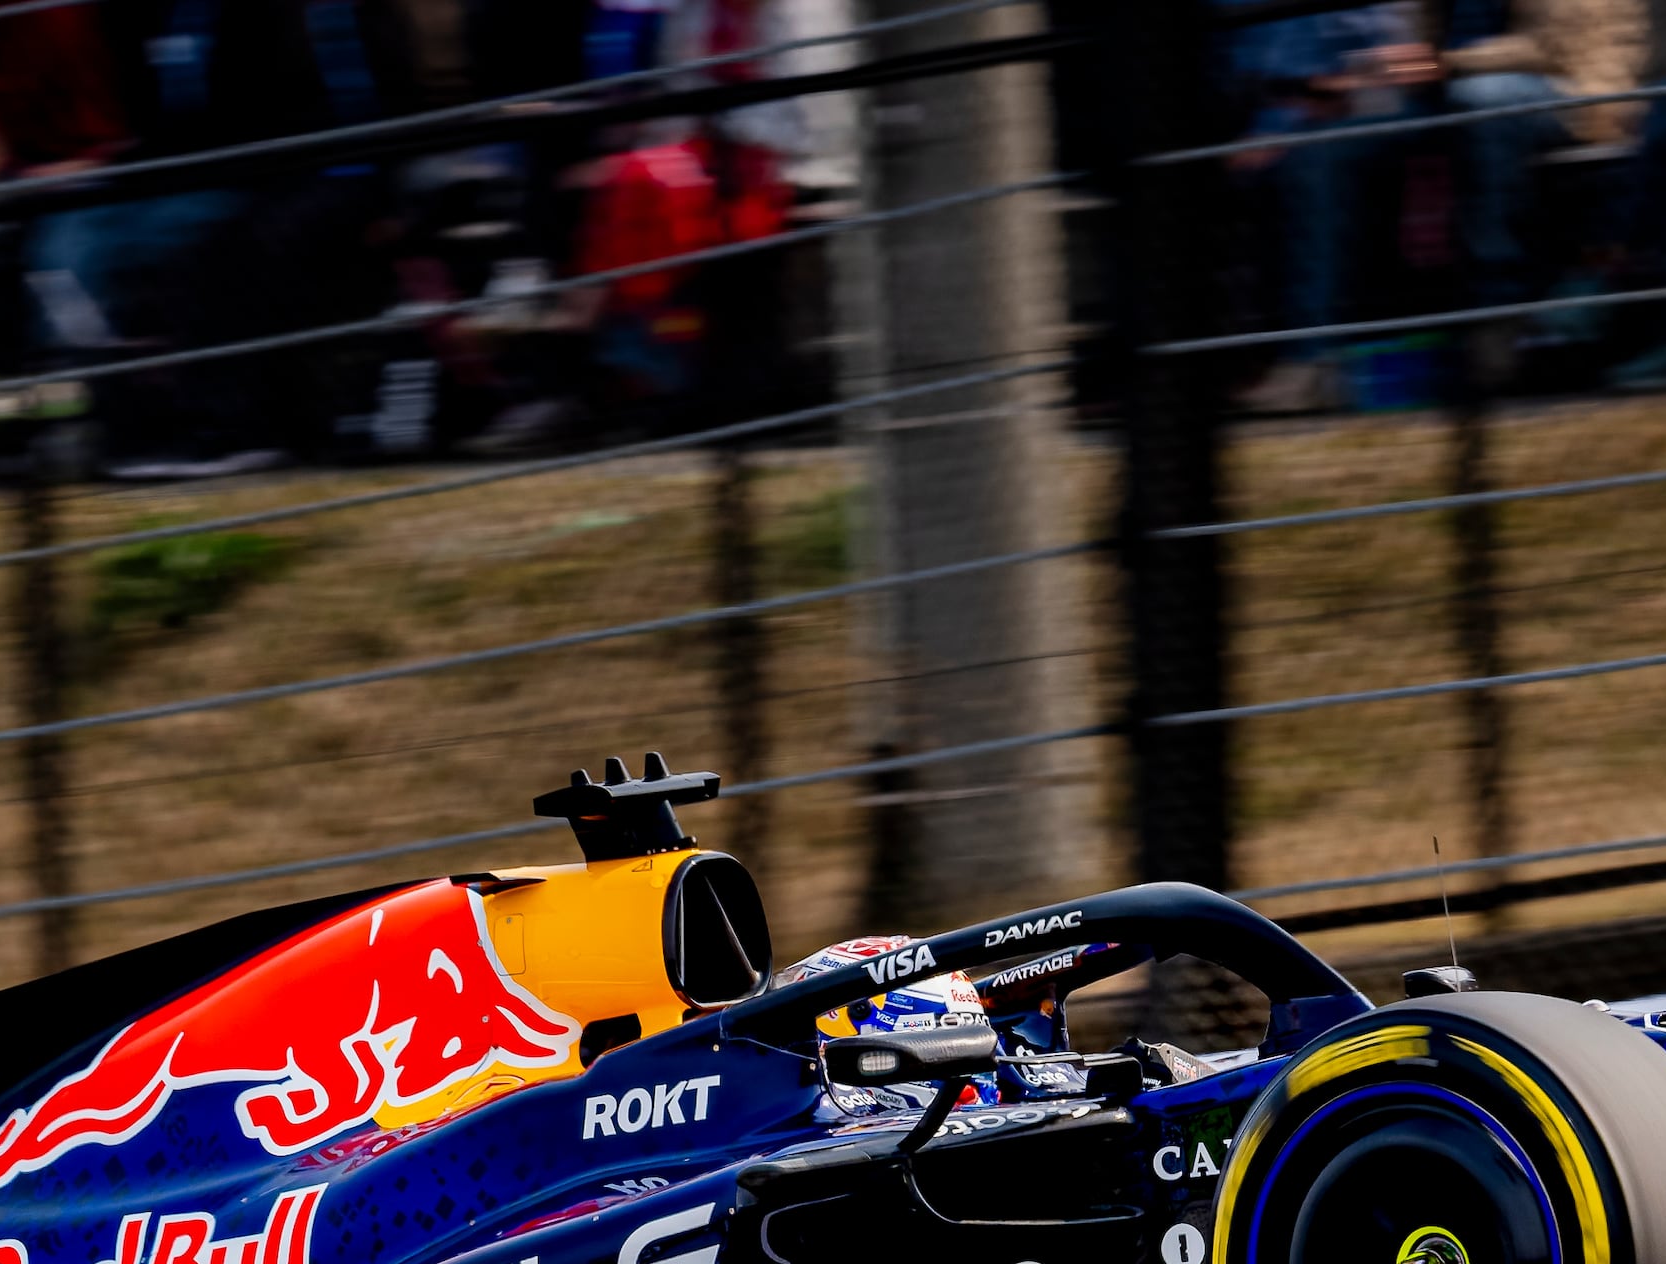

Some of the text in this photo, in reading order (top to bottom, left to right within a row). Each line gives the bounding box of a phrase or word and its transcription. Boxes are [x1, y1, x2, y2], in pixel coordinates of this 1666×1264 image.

[985, 910, 1083, 948] DAMAC
[861, 943, 937, 985] VISA
[992, 953, 1074, 988] AVATRADE
[875, 1011, 895, 1026] VISA
[582, 1075, 721, 1139] ROKT
[1153, 1138, 1233, 1181] CA
